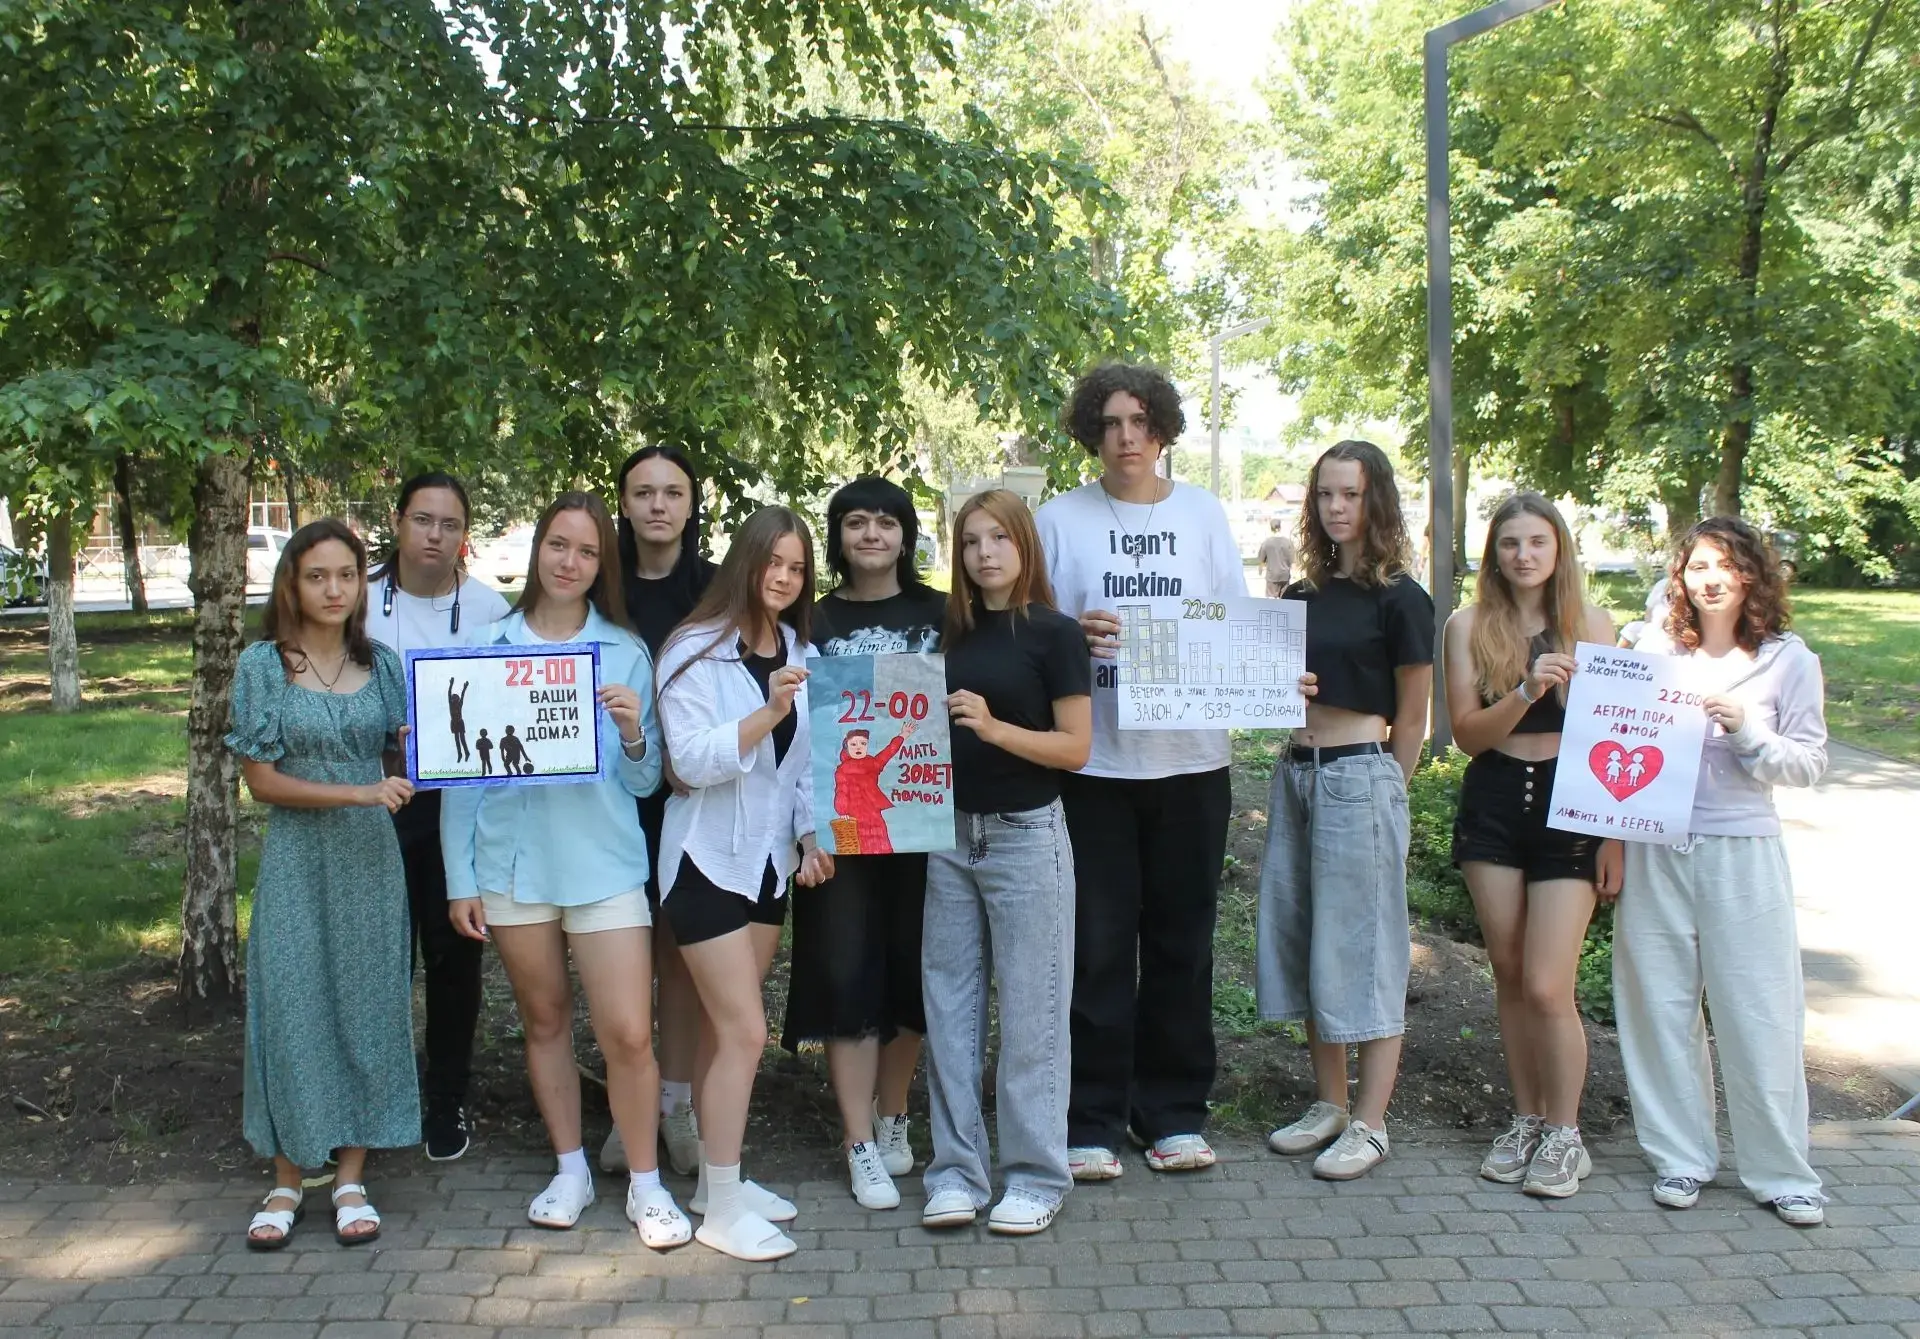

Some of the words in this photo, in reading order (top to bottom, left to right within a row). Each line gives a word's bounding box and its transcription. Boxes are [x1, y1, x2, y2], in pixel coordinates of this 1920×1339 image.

[1109, 530, 1116, 554] i
[1121, 531, 1176, 556] can't
[1181, 598, 1226, 621] 22:00
[844, 645, 853, 655] is
[856, 632, 887, 654] time
[890, 641, 903, 650] to
[1593, 655, 1607, 665] НА
[505, 658, 576, 686] 22-00
[1585, 662, 1618, 677] ЗАКОН
[1620, 669, 1654, 682] ТАКОЙ
[529, 689, 577, 704] ВАШИ
[1129, 685, 1166, 699] ВЕЧЕРОМ
[1174, 687, 1182, 697] НА
[1214, 687, 1244, 698] ПОЗДНО
[1262, 687, 1288, 700] ГУЛЯЙ
[1657, 688, 1703, 707] 22:00
[536, 706, 579, 724] ДЕТИ
[838, 689, 929, 723] 22-00
[1133, 702, 1172, 722] ЗАКОН
[1593, 704, 1636, 720] ДЕТЯМ
[1642, 710, 1674, 725] ПОРА
[525, 725, 580, 742] ДОМА?
[1610, 722, 1660, 739] ДОМОЙ
[899, 743, 938, 760] МАТЬ
[898, 762, 952, 789] ЗОВЕТ
[1556, 807, 1599, 824] ЛЮБИТЬ
[1606, 815, 1614, 825] И
[1621, 816, 1665, 834] БЕРЕЧЬ
